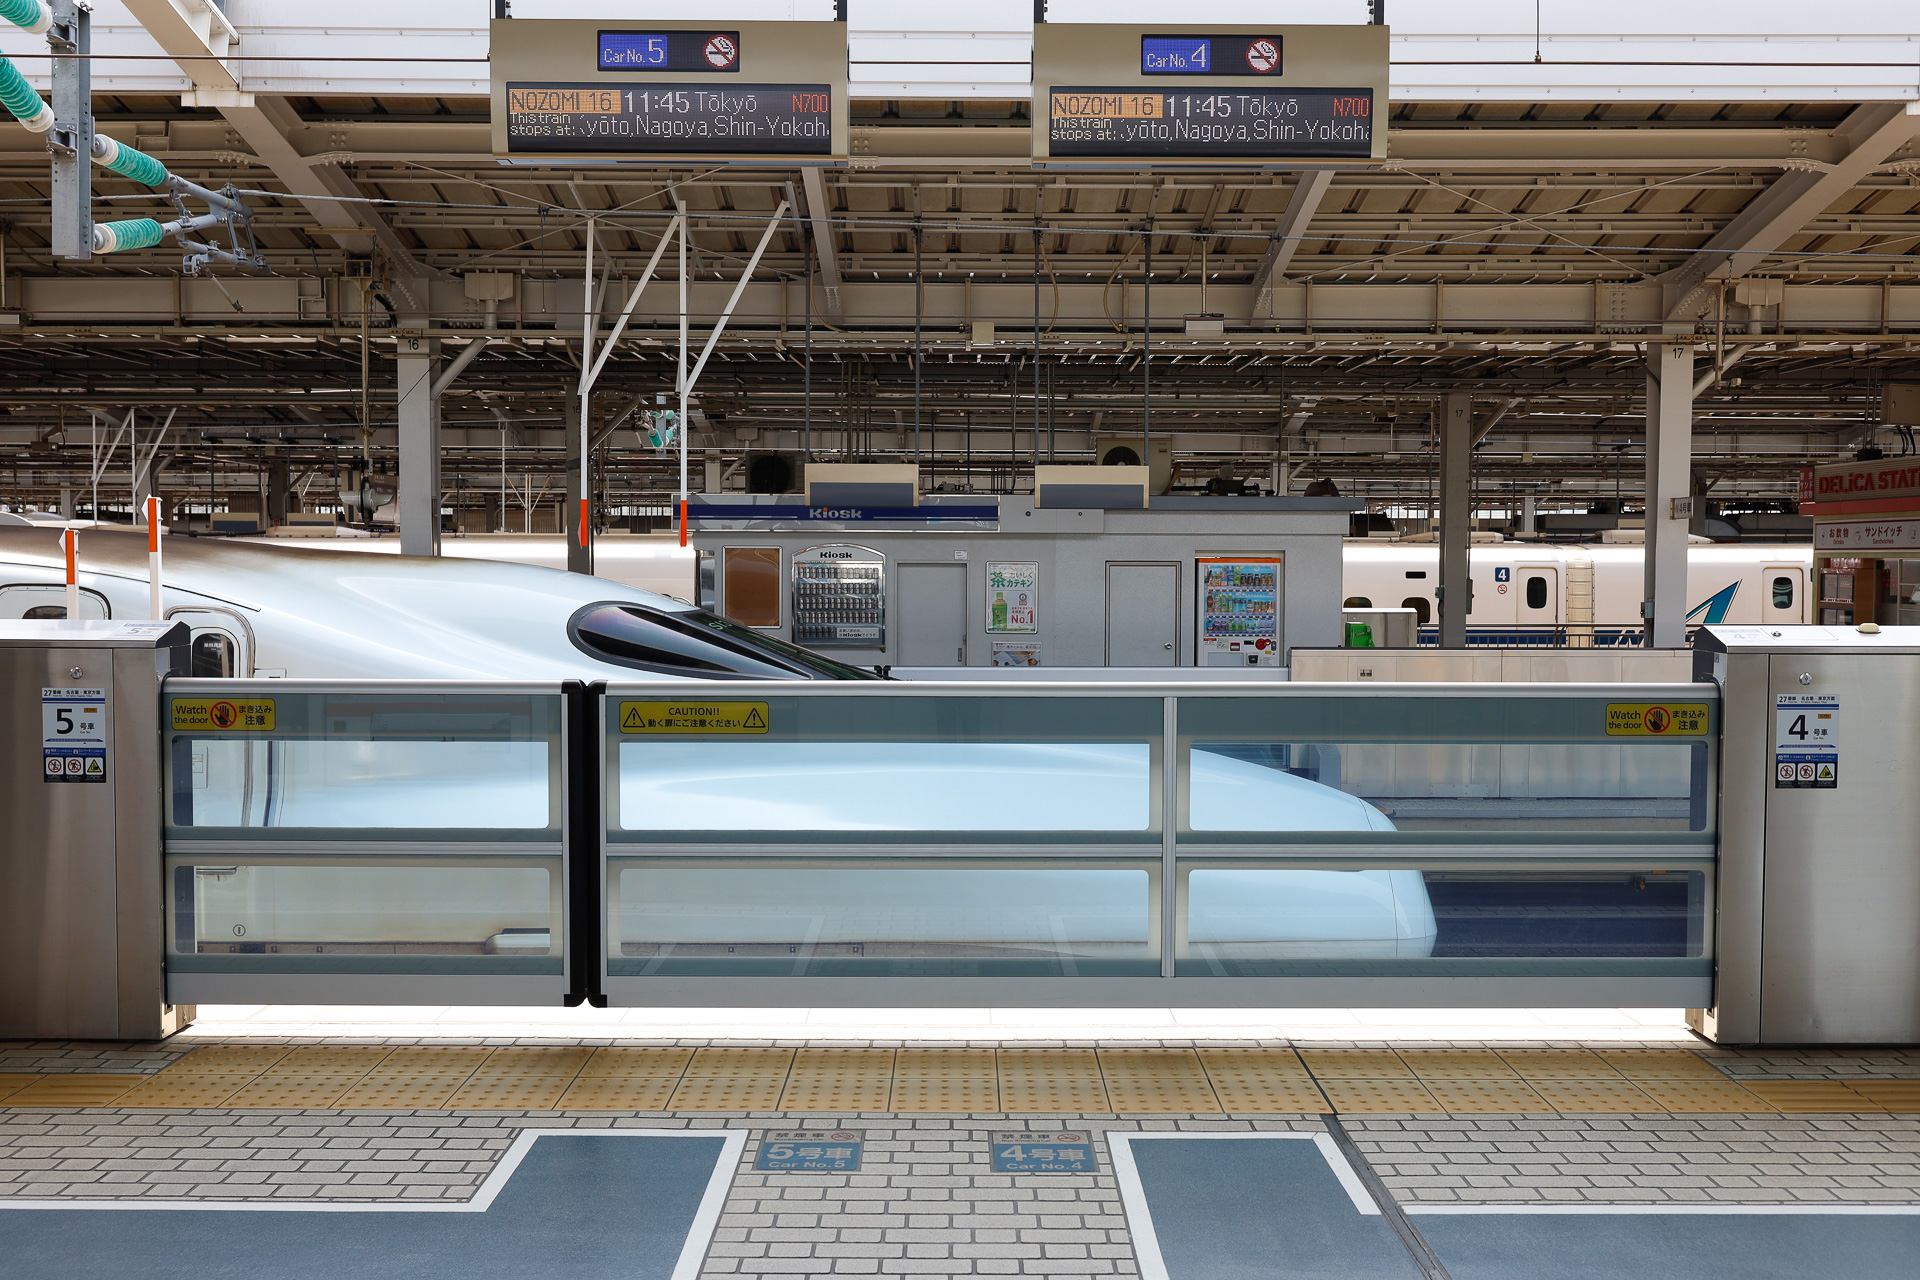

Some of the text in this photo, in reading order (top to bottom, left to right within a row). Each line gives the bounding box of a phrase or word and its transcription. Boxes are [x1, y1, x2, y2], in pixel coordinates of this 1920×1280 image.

[648, 39, 664, 64] 5
[1191, 43, 1207, 68] 4
[511, 91, 757, 115] NOZOMI 16 11:45 Tōkyō
[792, 93, 829, 113] N700
[1053, 95, 1298, 120] NOZOMI 16 11:45 Tōkyō
[1333, 98, 1369, 117] N700
[510, 124, 551, 137] stops
[714, 116, 830, 137] Shin-Yokoh
[1052, 129, 1091, 141] stops
[408, 338, 419, 351] 16
[1672, 347, 1684, 359] 17
[1455, 409, 1464, 418] 17
[809, 507, 862, 519] Kiosk
[1829, 527, 1849, 539] お飲物
[1864, 525, 1903, 538] サンドイッチ
[820, 551, 853, 559] Kiosk
[990, 571, 1007, 588] 茶
[1497, 569, 1507, 581] 4
[1006, 579, 1034, 588] カテキン
[1011, 610, 1034, 624] No.1
[175, 705, 208, 715] Watch
[238, 704, 272, 715] まき込み
[668, 707, 721, 716] CAUTION!!
[1609, 710, 1642, 720] Watch
[1672, 710, 1706, 719] まき込み
[56, 708, 74, 735] 5
[173, 716, 209, 724] the door
[245, 715, 266, 726] 注意
[1608, 721, 1642, 729] the door
[1678, 720, 1699, 731] 注意
[1788, 714, 1809, 741] 4
[767, 1144, 854, 1160] 5号車
[1000, 1145, 1087, 1161] 4号車
